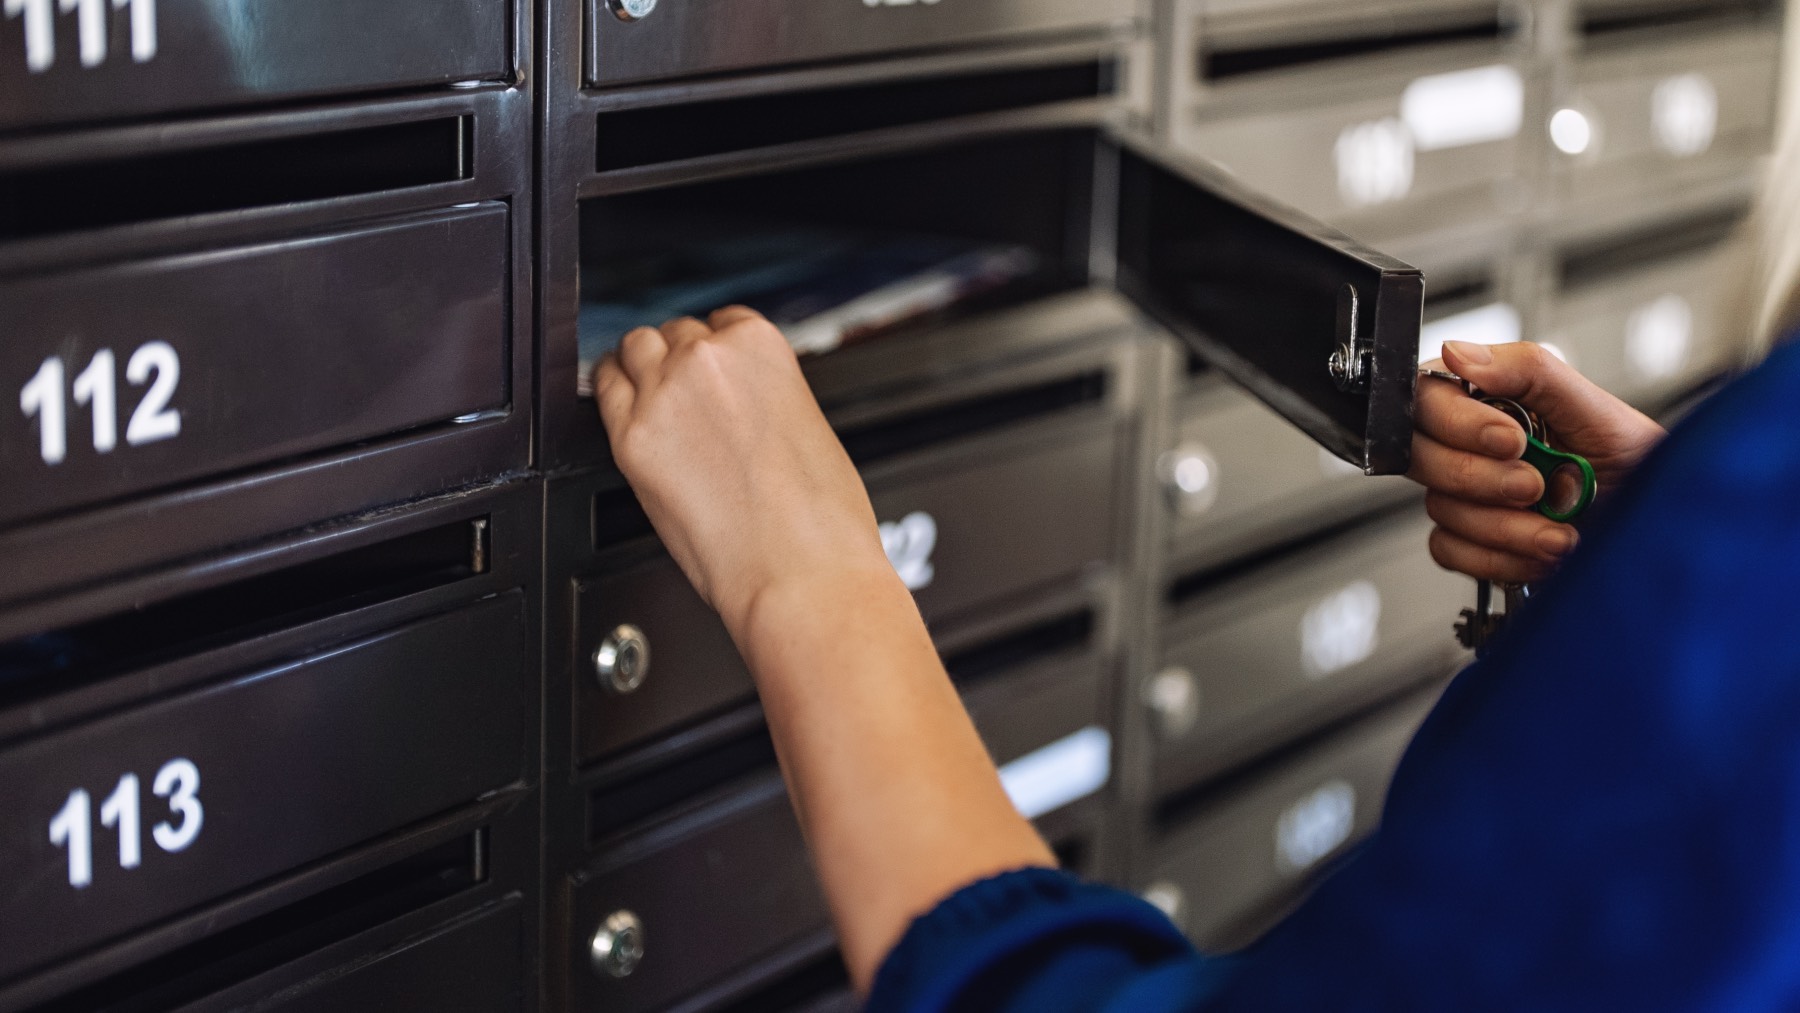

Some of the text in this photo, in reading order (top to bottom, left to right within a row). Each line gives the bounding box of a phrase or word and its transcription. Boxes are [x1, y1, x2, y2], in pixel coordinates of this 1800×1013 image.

[3, 0, 157, 72] 111
[20, 340, 182, 465] 112
[49, 757, 204, 889] 113
